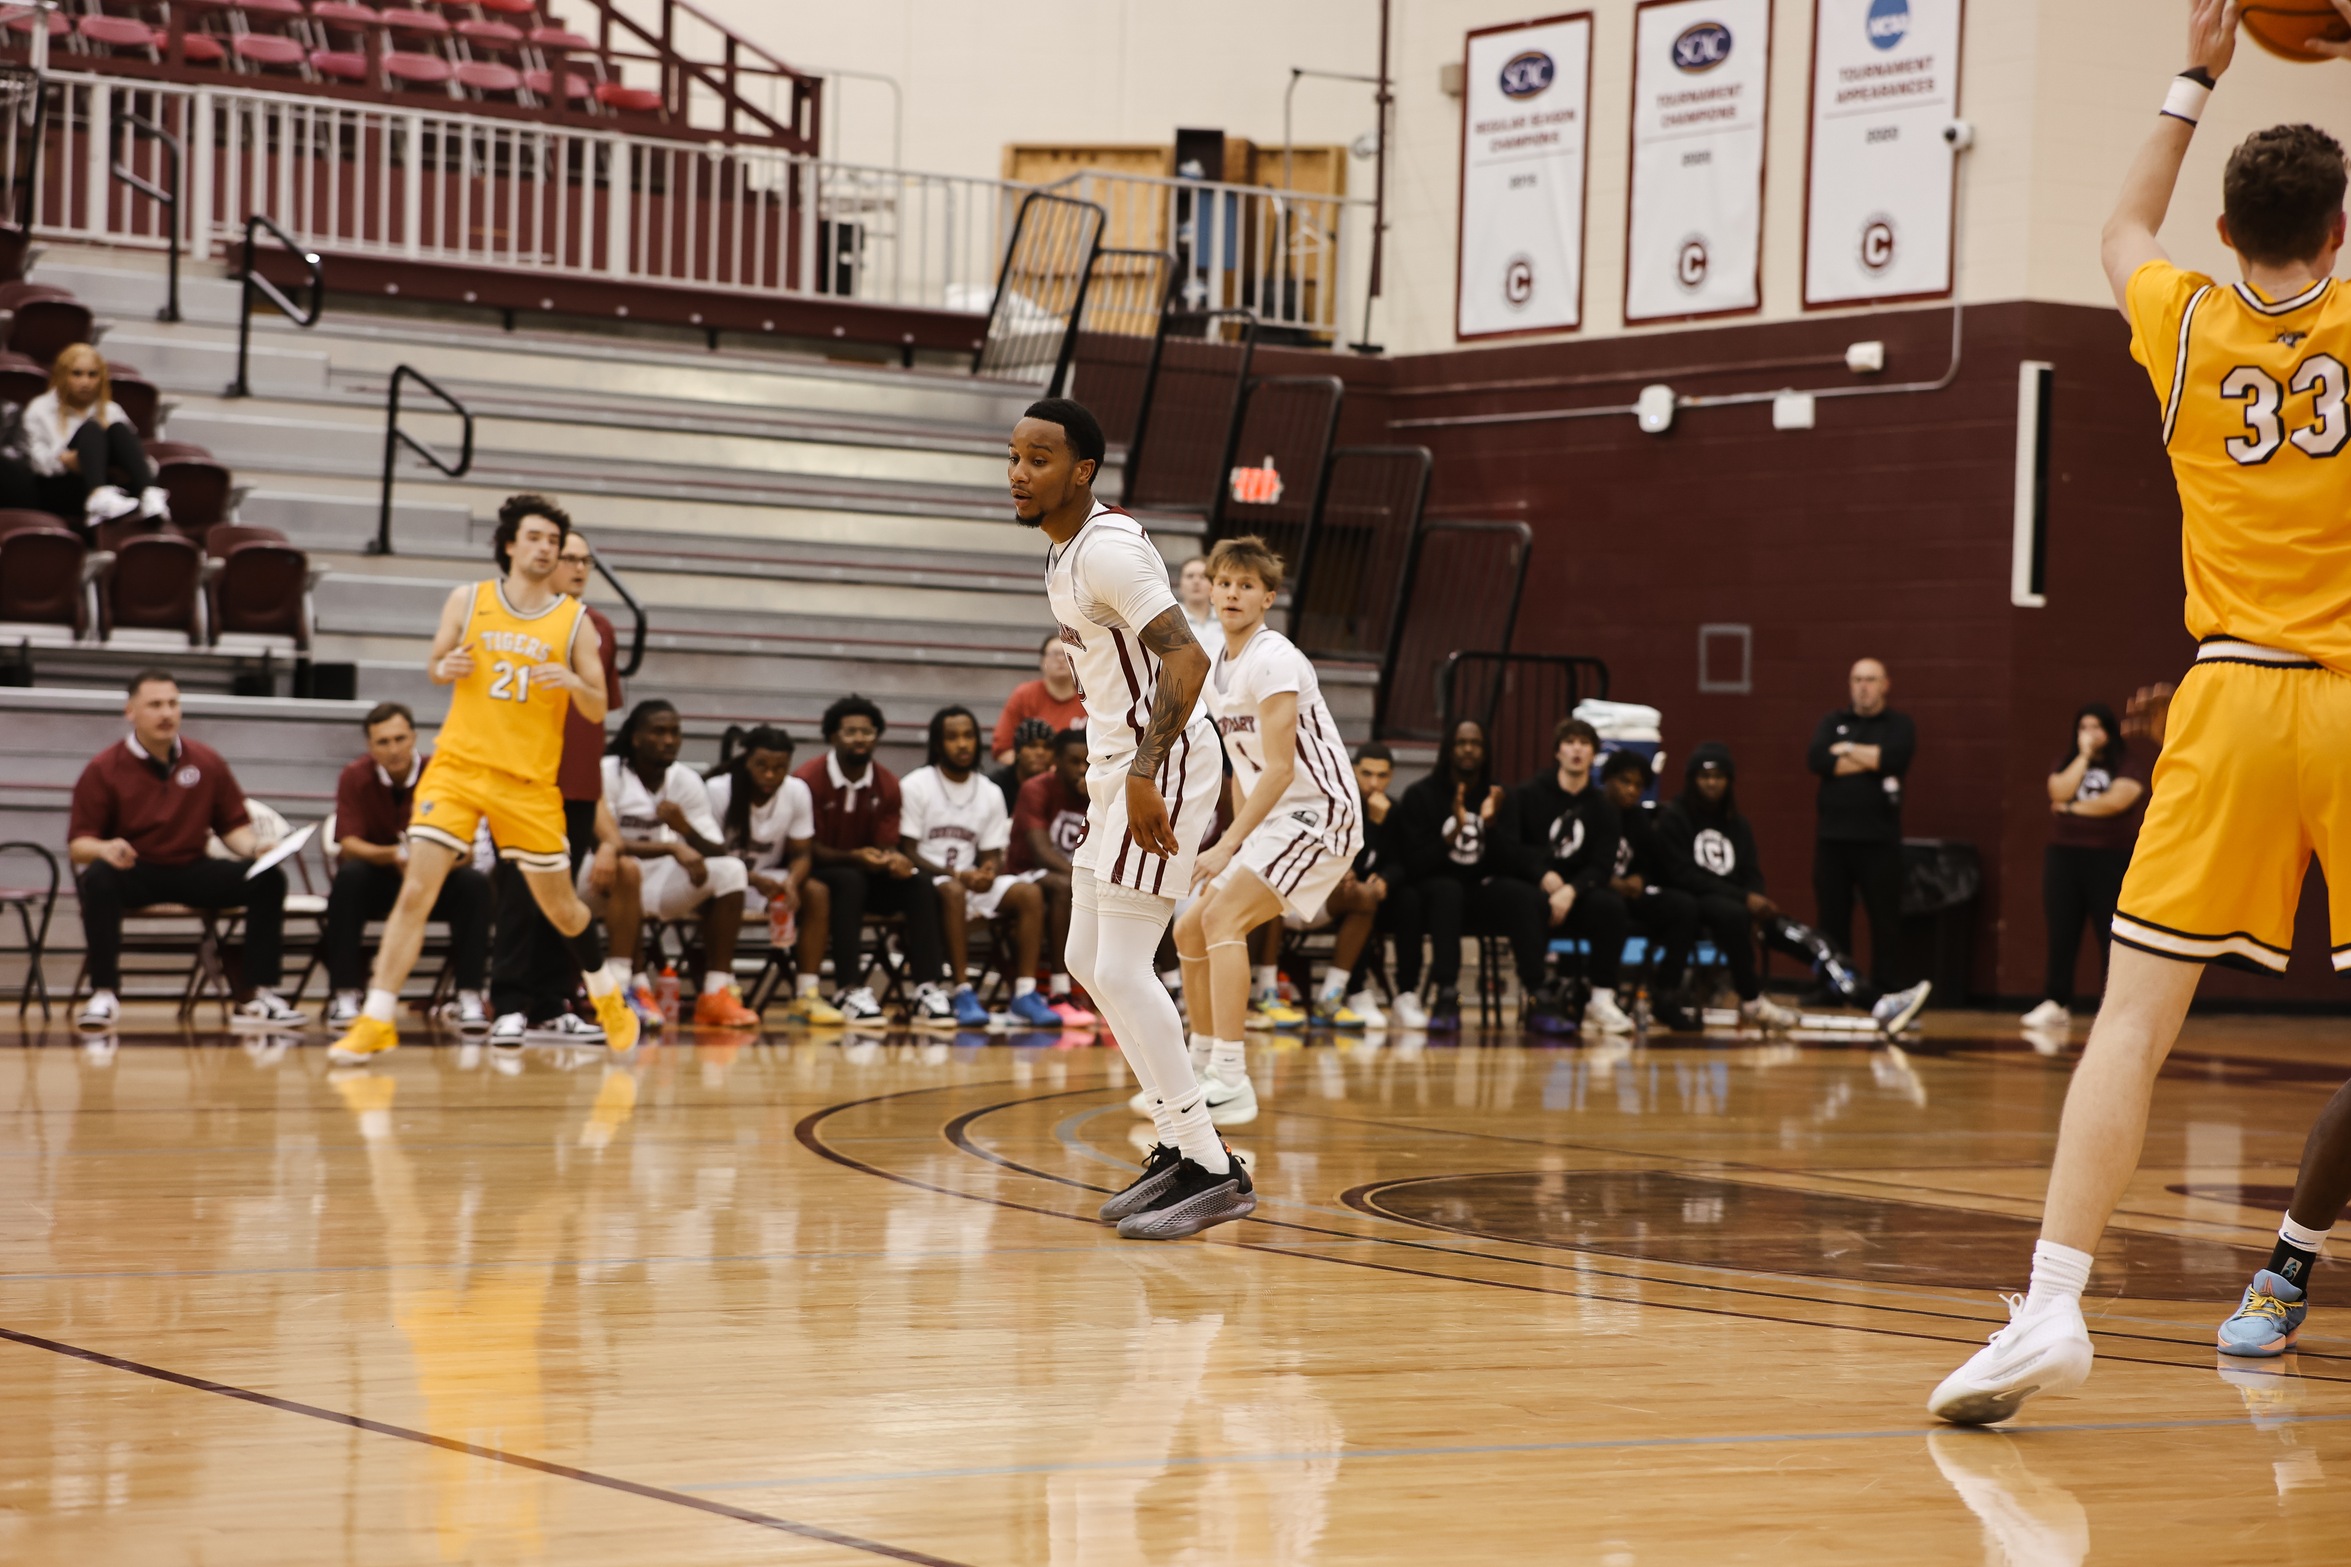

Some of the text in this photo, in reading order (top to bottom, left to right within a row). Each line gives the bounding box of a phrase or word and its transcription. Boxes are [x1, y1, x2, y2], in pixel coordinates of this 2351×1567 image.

[1838, 56, 1934, 81] TOURNAMENT
[1657, 84, 1742, 108] TOURNAMENT
[1835, 78, 1935, 104] APPEARANCES
[1661, 105, 1736, 128] CHAMPIONS
[1490, 132, 1560, 152] CHAMPIONS
[2220, 352, 2351, 466] 33
[480, 630, 552, 662] TIGERS
[489, 660, 531, 703] 21
